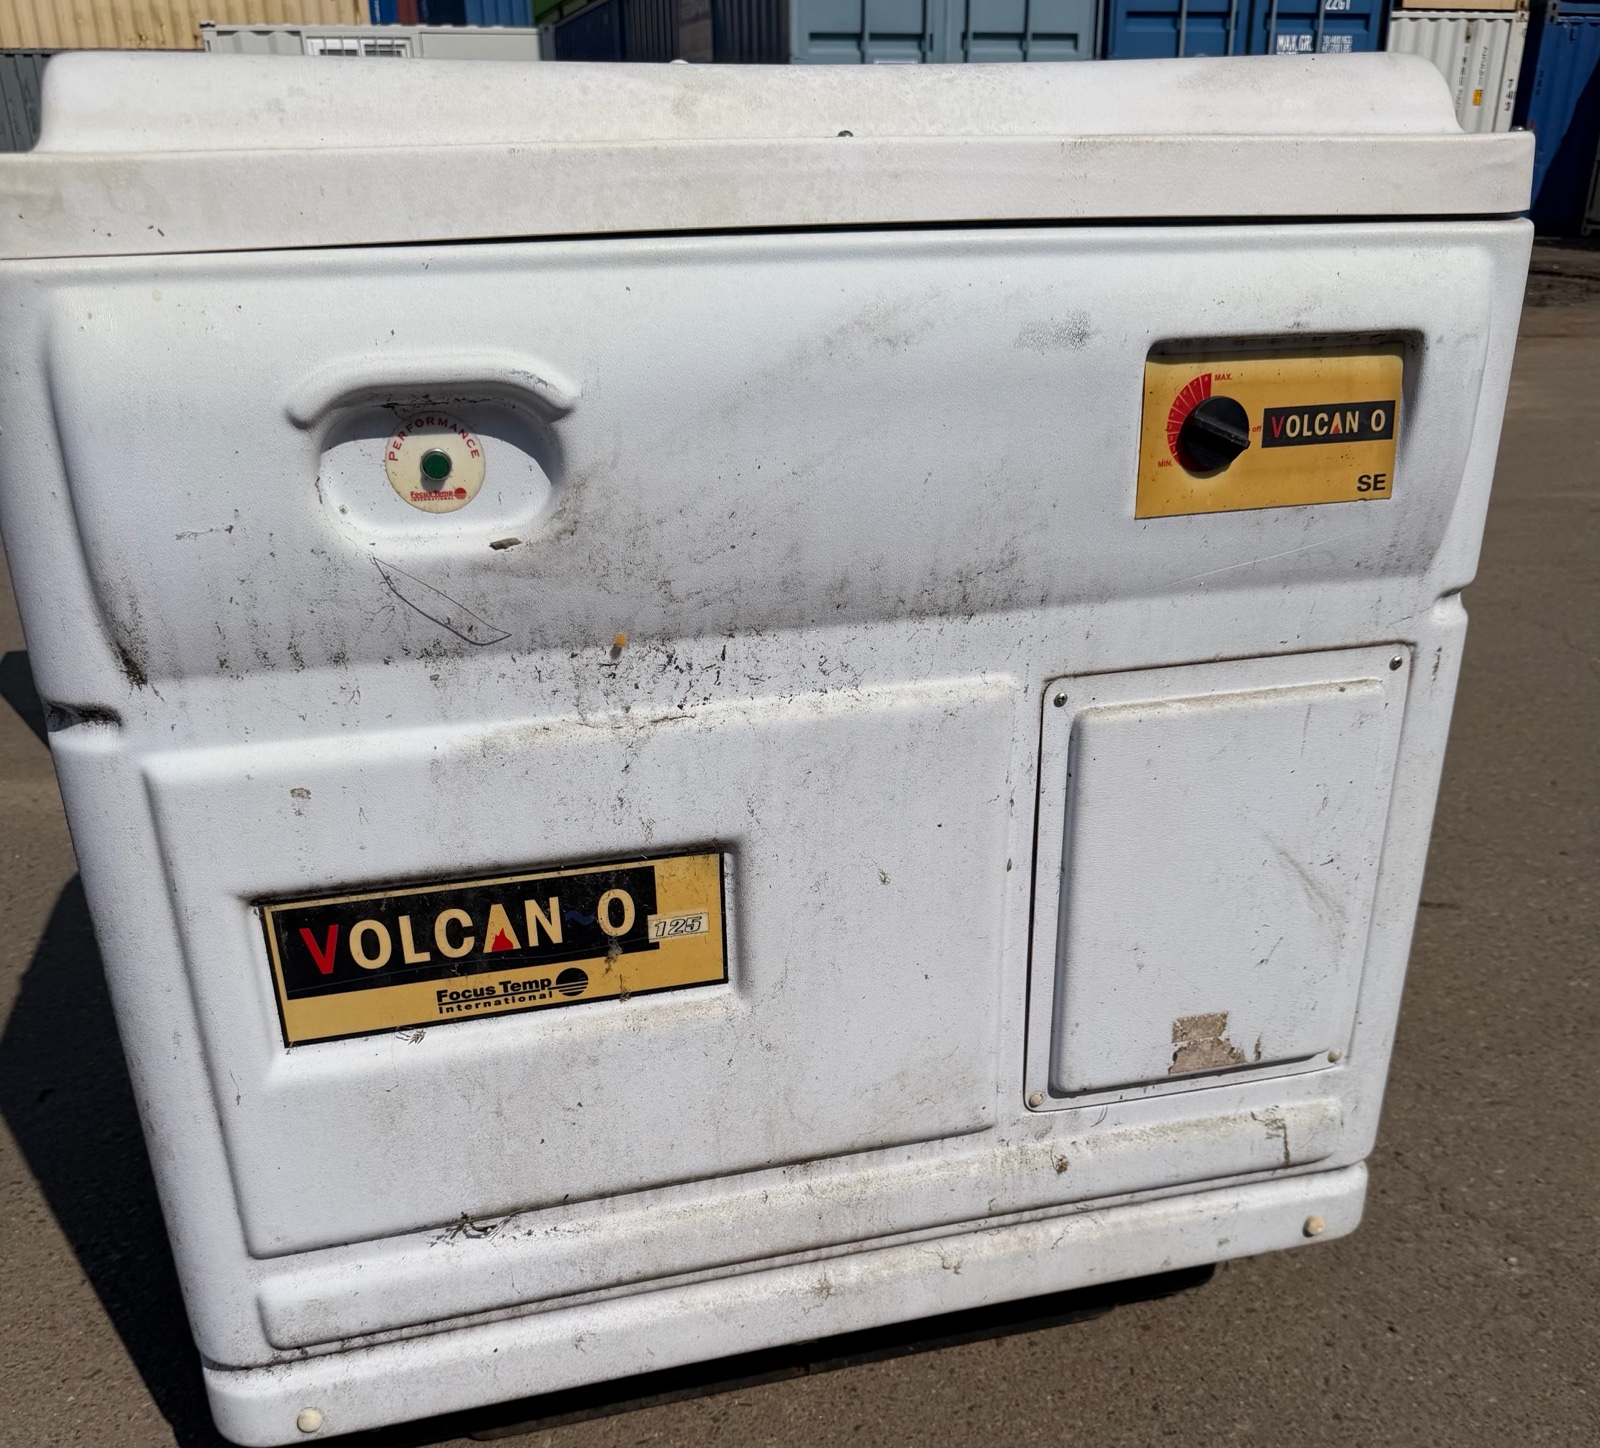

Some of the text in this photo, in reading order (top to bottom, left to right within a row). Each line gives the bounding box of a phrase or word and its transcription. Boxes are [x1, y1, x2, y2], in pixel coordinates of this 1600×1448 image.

[1214, 373, 1233, 382] MAX.
[388, 416, 480, 461] PERFORMANCE
[1356, 473, 1386, 492] SE
[655, 915, 703, 937] 125
[436, 977, 552, 1003] Focus Temp
[438, 990, 553, 1014] International
